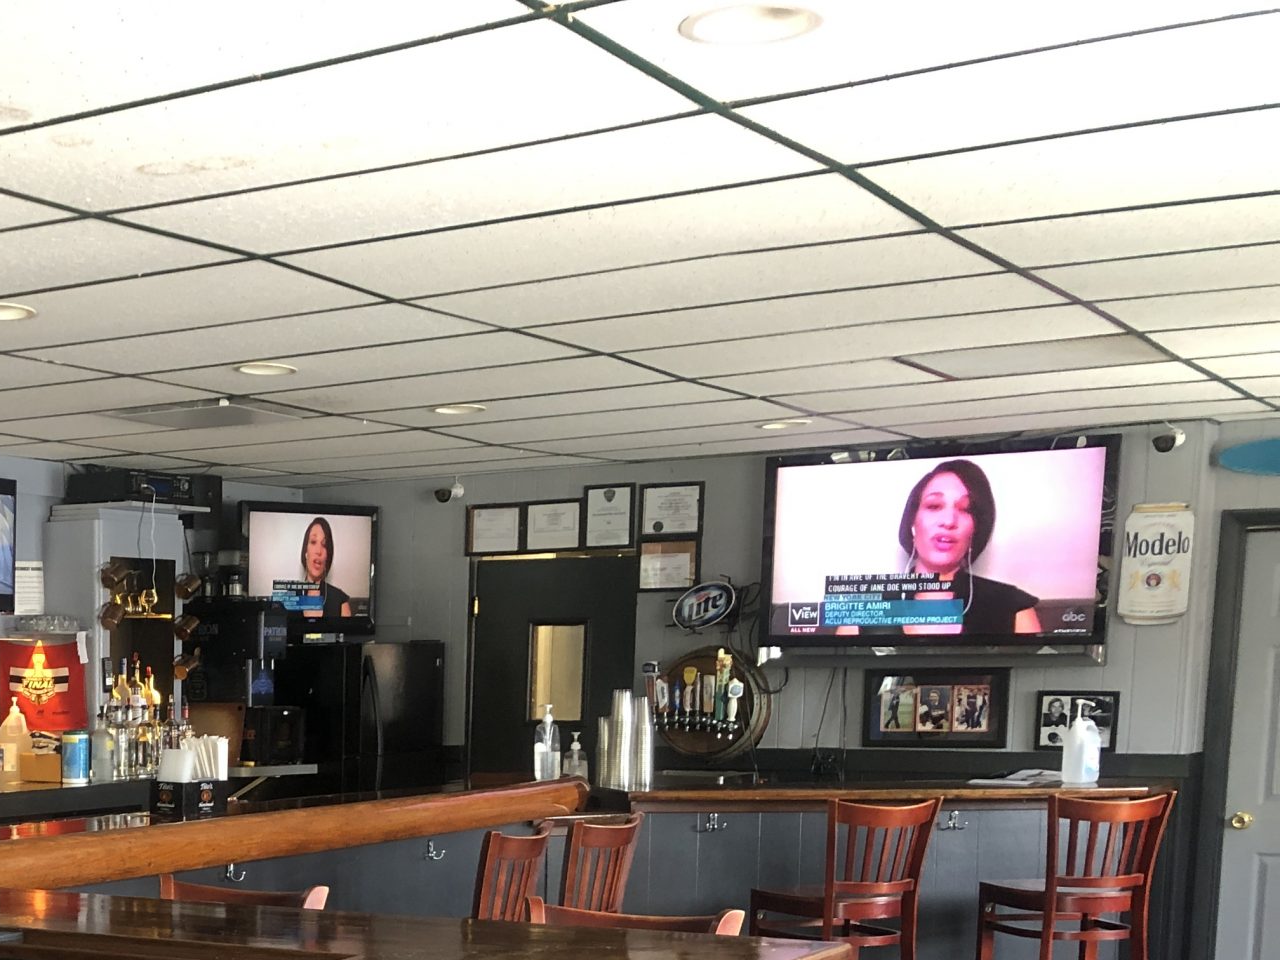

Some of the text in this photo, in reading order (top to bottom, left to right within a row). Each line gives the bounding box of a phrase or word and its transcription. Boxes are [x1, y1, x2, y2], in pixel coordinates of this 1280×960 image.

[1125, 530, 1190, 558] Modelo
[828, 584, 858, 592] COURAGE
[859, 584, 868, 592] OF
[887, 583, 900, 591] DOE
[901, 582, 917, 591] WHO
[918, 582, 940, 590] STOOD
[941, 582, 951, 590] UP
[824, 601, 891, 611] BRIGITTE AMIRI
[824, 610, 850, 618] DEPUTY
[1062, 611, 1087, 621] abc
[824, 617, 838, 625] ACLU
[926, 615, 957, 623] PROJECT
